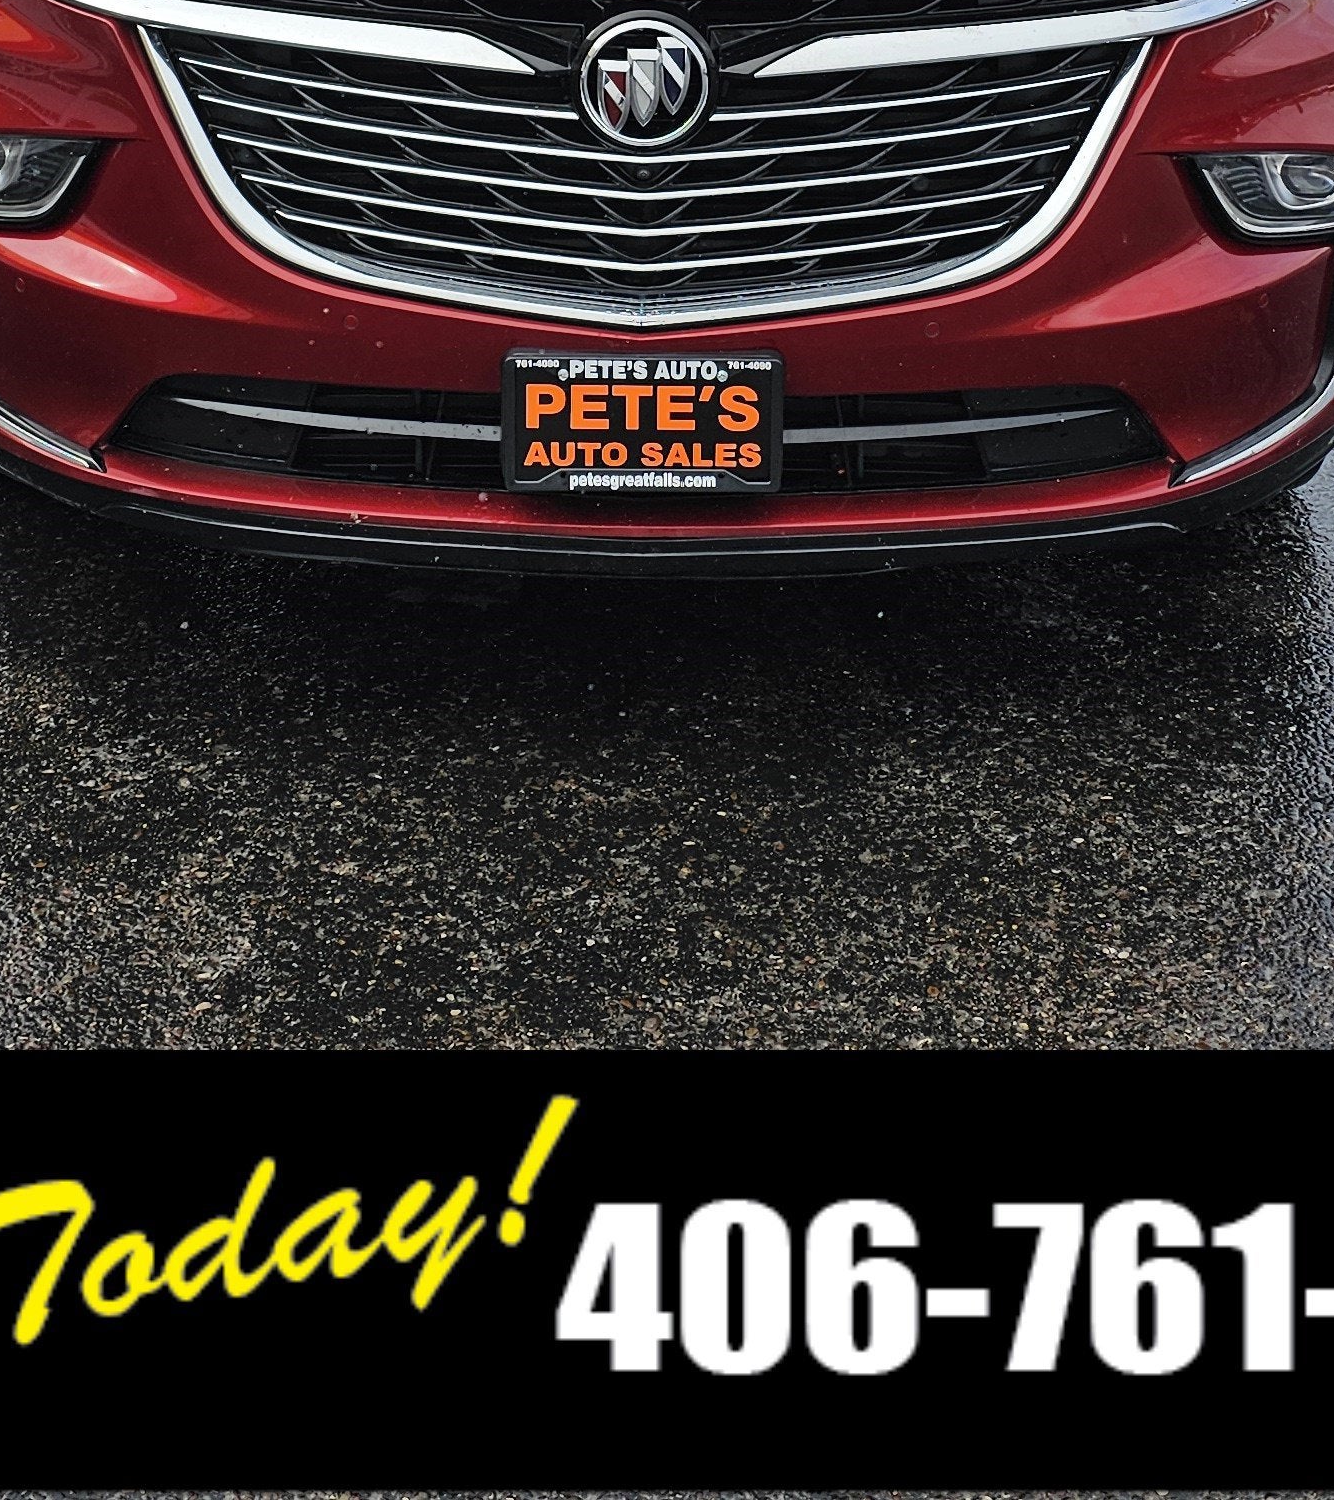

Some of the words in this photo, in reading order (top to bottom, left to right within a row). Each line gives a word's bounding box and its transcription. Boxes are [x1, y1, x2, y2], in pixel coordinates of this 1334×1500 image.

[569, 359, 648, 380] PETE'S
[653, 360, 718, 381] AUTO
[525, 383, 760, 432] PETE'S
[523, 441, 628, 467] AUTO
[640, 442, 762, 468] SALES
[569, 471, 717, 491] petesgreatfalls.com
